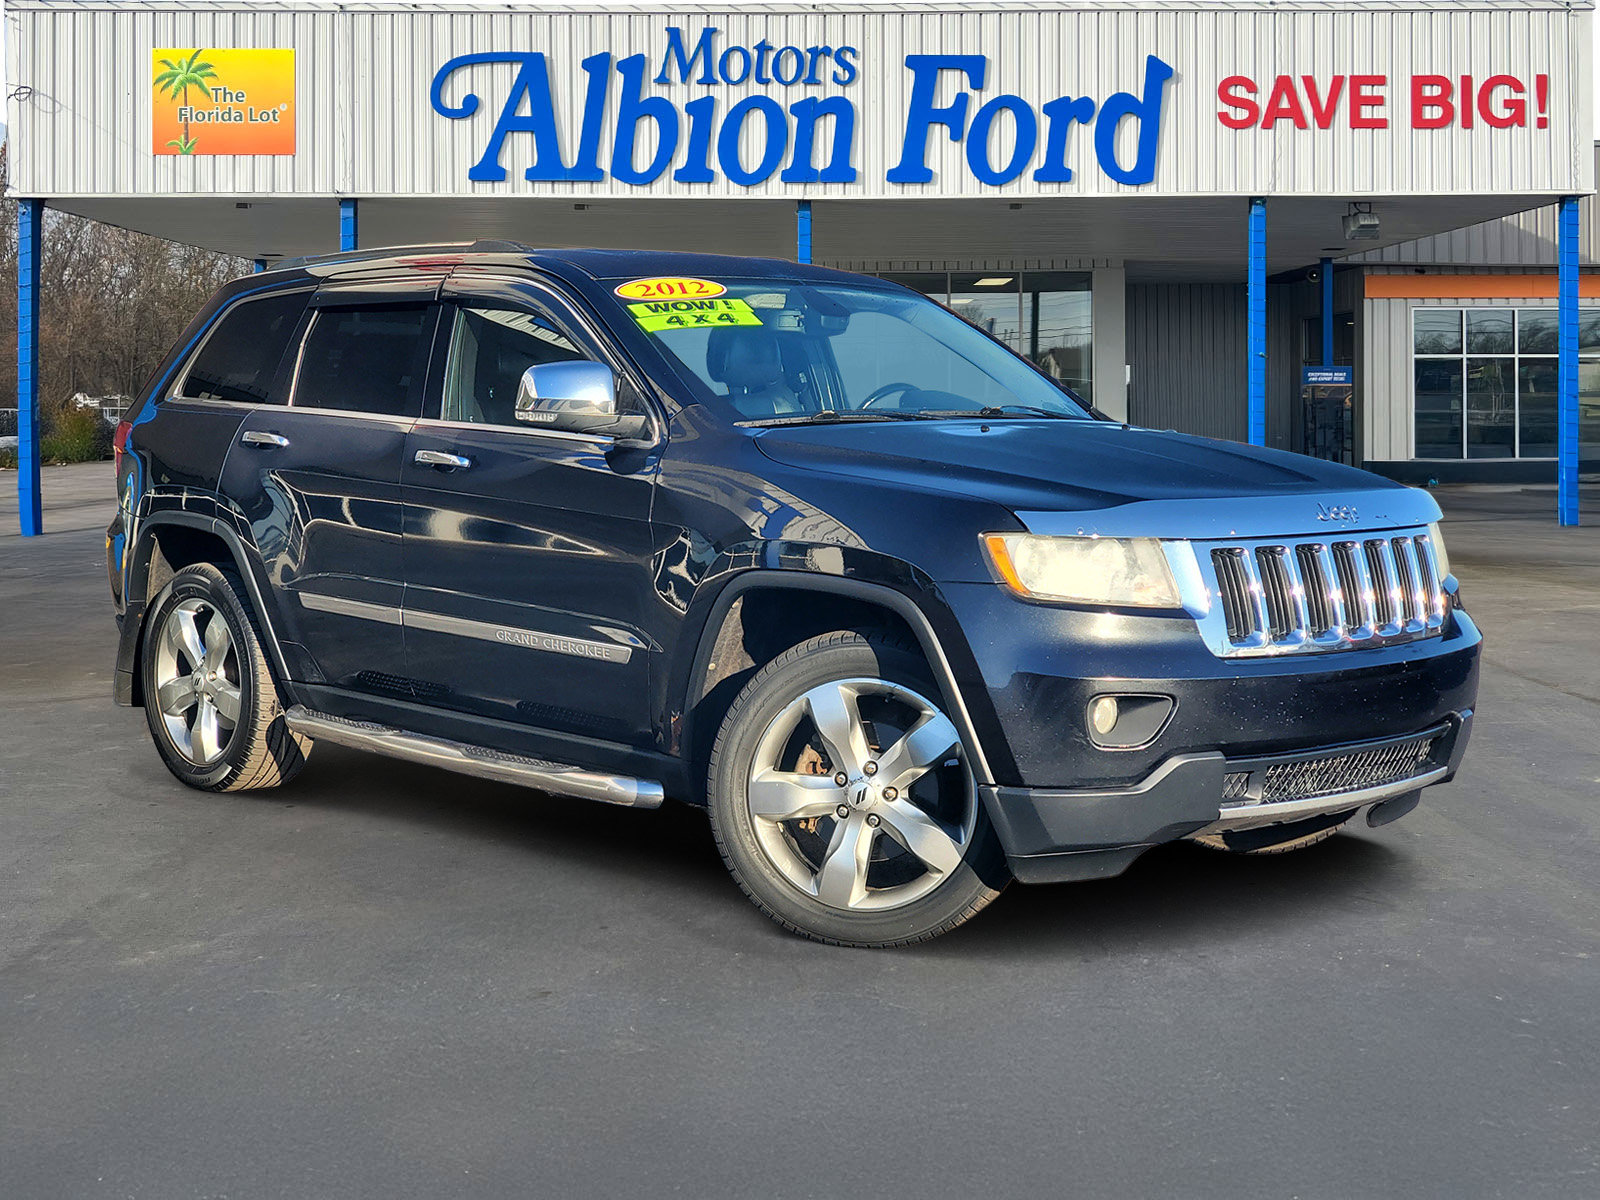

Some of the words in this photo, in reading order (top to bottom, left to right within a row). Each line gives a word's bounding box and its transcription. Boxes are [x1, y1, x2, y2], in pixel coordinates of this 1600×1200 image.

[654, 27, 857, 86] Motors
[211, 86, 246, 103] The
[1217, 74, 1388, 129] SAVE
[1410, 74, 1548, 129] BIG!
[178, 106, 244, 122] Florida
[430, 52, 857, 186] Albion
[886, 54, 1174, 186] Ford
[635, 281, 710, 297] 2012
[1316, 502, 1360, 524] Jeep
[495, 630, 539, 647] GRAND
[542, 638, 611, 659] CHEROKEE
